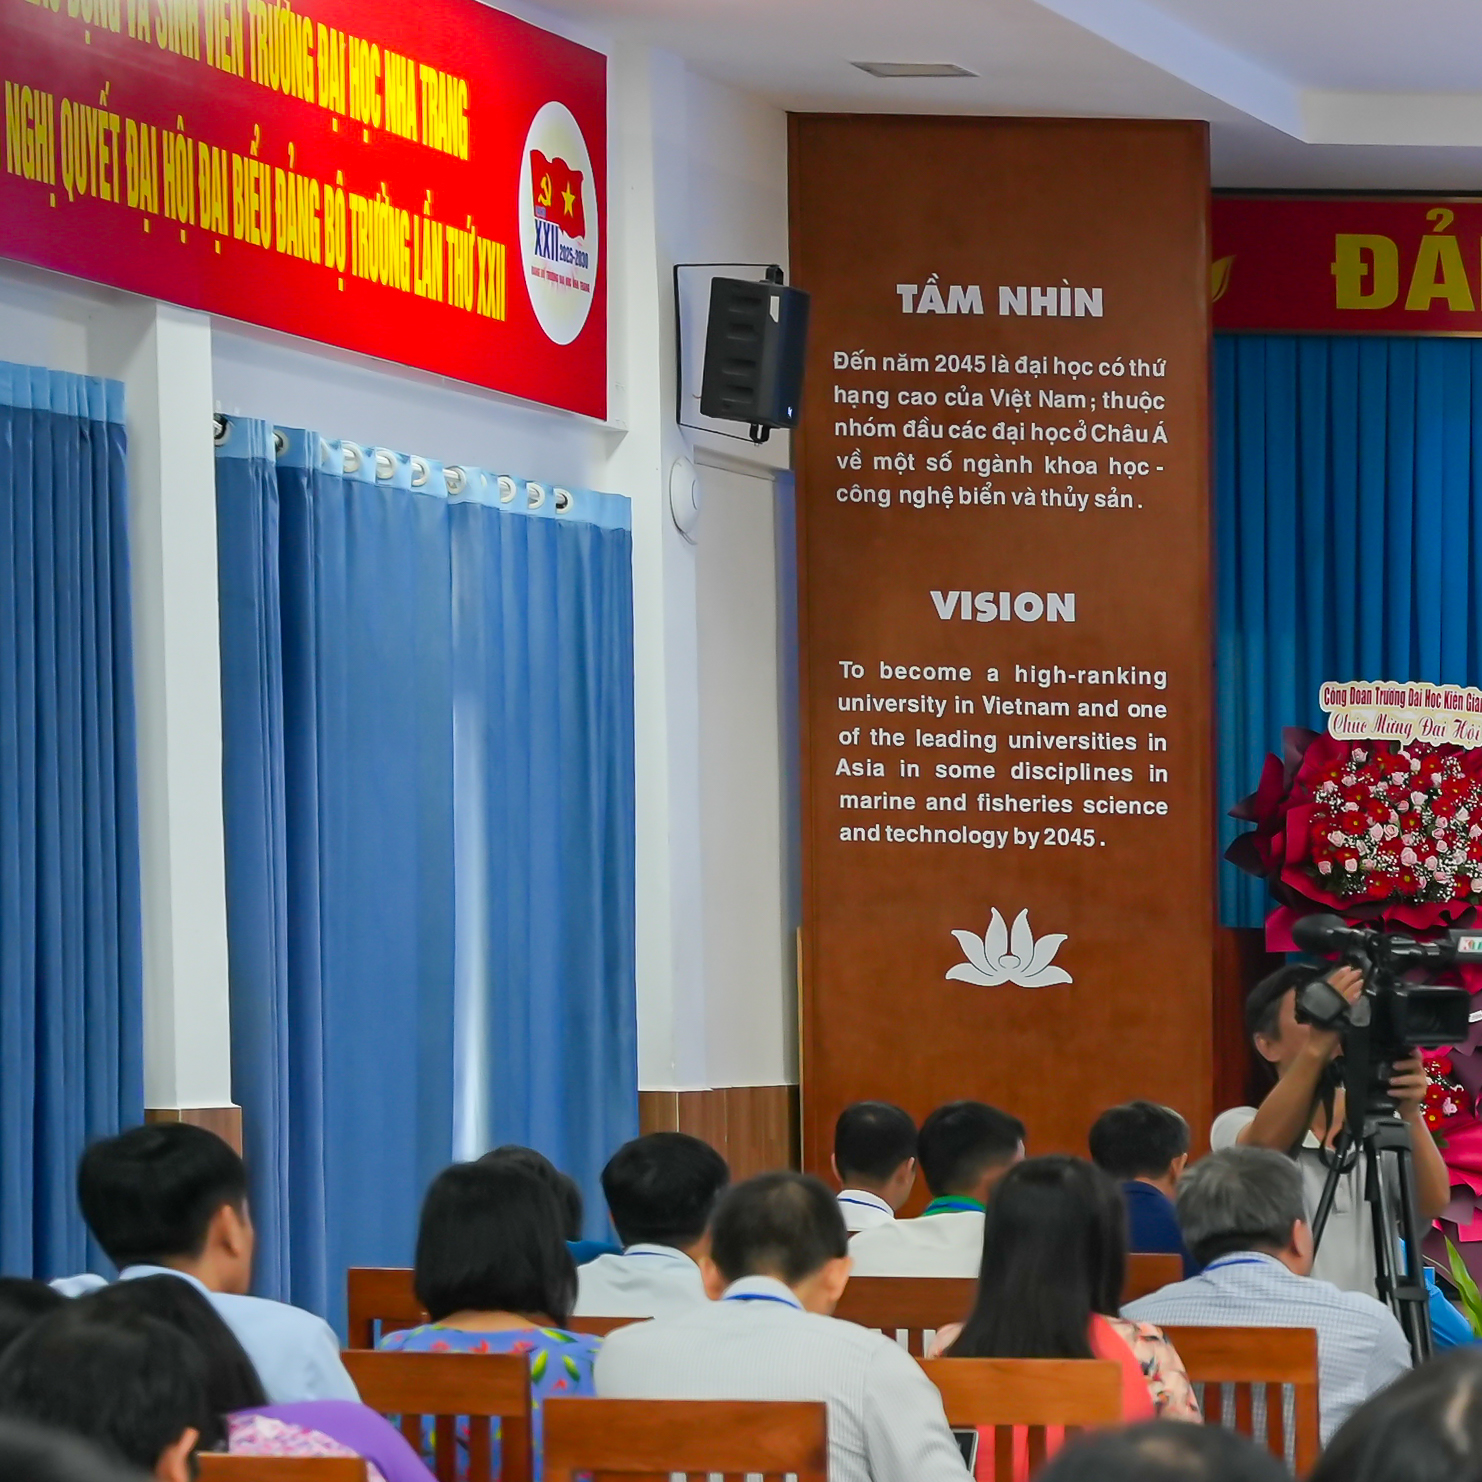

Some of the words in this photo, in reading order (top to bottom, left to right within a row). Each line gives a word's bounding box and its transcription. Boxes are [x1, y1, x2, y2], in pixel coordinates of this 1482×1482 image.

[317, 22, 346, 132] ĐẠI
[348, 35, 381, 143] HỌC
[384, 49, 418, 142] NHA
[419, 63, 468, 161] TRANG
[5, 81, 56, 208] NGHỊ
[60, 81, 120, 204] QUYẾT
[125, 118, 159, 233] ĐẠI
[162, 114, 195, 244] HỘI
[198, 141, 229, 254] ĐẠI
[232, 123, 271, 250] BIỂU
[275, 141, 321, 265] ĐẢNG
[323, 170, 346, 291] BỘ
[349, 182, 411, 293] TRƯỜNG
[413, 190, 443, 302] LẦN
[445, 215, 476, 312] THỨ
[476, 235, 506, 322] XXII
[534, 218, 559, 262] XXII
[896, 272, 984, 315] TẦM
[998, 278, 1104, 318] NHÌN
[833, 349, 876, 371] Đến
[882, 353, 929, 372] năm
[934, 354, 986, 373] 2045
[991, 353, 1010, 373] là
[1014, 355, 1048, 379] đại
[1053, 356, 1094, 381] học
[1098, 356, 1125, 377] có
[1128, 357, 1167, 377] thứ
[834, 384, 889, 409] hạng
[897, 391, 938, 406] cao
[944, 384, 984, 407] của
[1101, 390, 1165, 414] thuộc
[835, 416, 896, 438] nhóm
[902, 415, 944, 439] đầu
[948, 419, 987, 440] các
[992, 421, 1025, 445] đại
[1031, 422, 1071, 446] học
[1073, 419, 1087, 442] ở
[1090, 423, 1148, 443] Châu
[1151, 420, 1168, 444] Á
[836, 447, 862, 470] về
[873, 452, 916, 476] một
[926, 450, 953, 472] số
[963, 453, 1033, 478] ngành
[1044, 455, 1098, 475] khoa
[1109, 456, 1150, 480] học
[836, 483, 891, 508] công
[899, 485, 954, 509] nghệ
[958, 481, 1006, 505] biển
[1011, 486, 1036, 506] và
[1040, 485, 1090, 512] thủy
[929, 590, 1076, 623] VISION
[838, 660, 865, 679] To
[880, 660, 972, 682] become
[987, 667, 999, 682] a
[1015, 664, 1167, 690] high-ranking
[838, 693, 947, 718] university
[954, 695, 974, 714] in
[981, 695, 1070, 716] Vietnam
[1077, 699, 1119, 718] and
[1127, 703, 1168, 719] one
[838, 727, 860, 746] of
[869, 727, 905, 747] the
[916, 728, 997, 754] leading
[1008, 730, 1137, 751] universities
[1148, 732, 1167, 752] in
[835, 757, 885, 777] Asia
[900, 759, 920, 778] in
[935, 764, 996, 779] some
[1010, 761, 1133, 785] disciplines
[1149, 764, 1168, 783] in
[839, 791, 916, 810] marine
[925, 792, 967, 811] and
[976, 792, 1073, 814] fisheries
[1082, 795, 1169, 816] science
[839, 823, 881, 842] and
[884, 824, 1009, 849] technology
[1013, 826, 1040, 850] by
